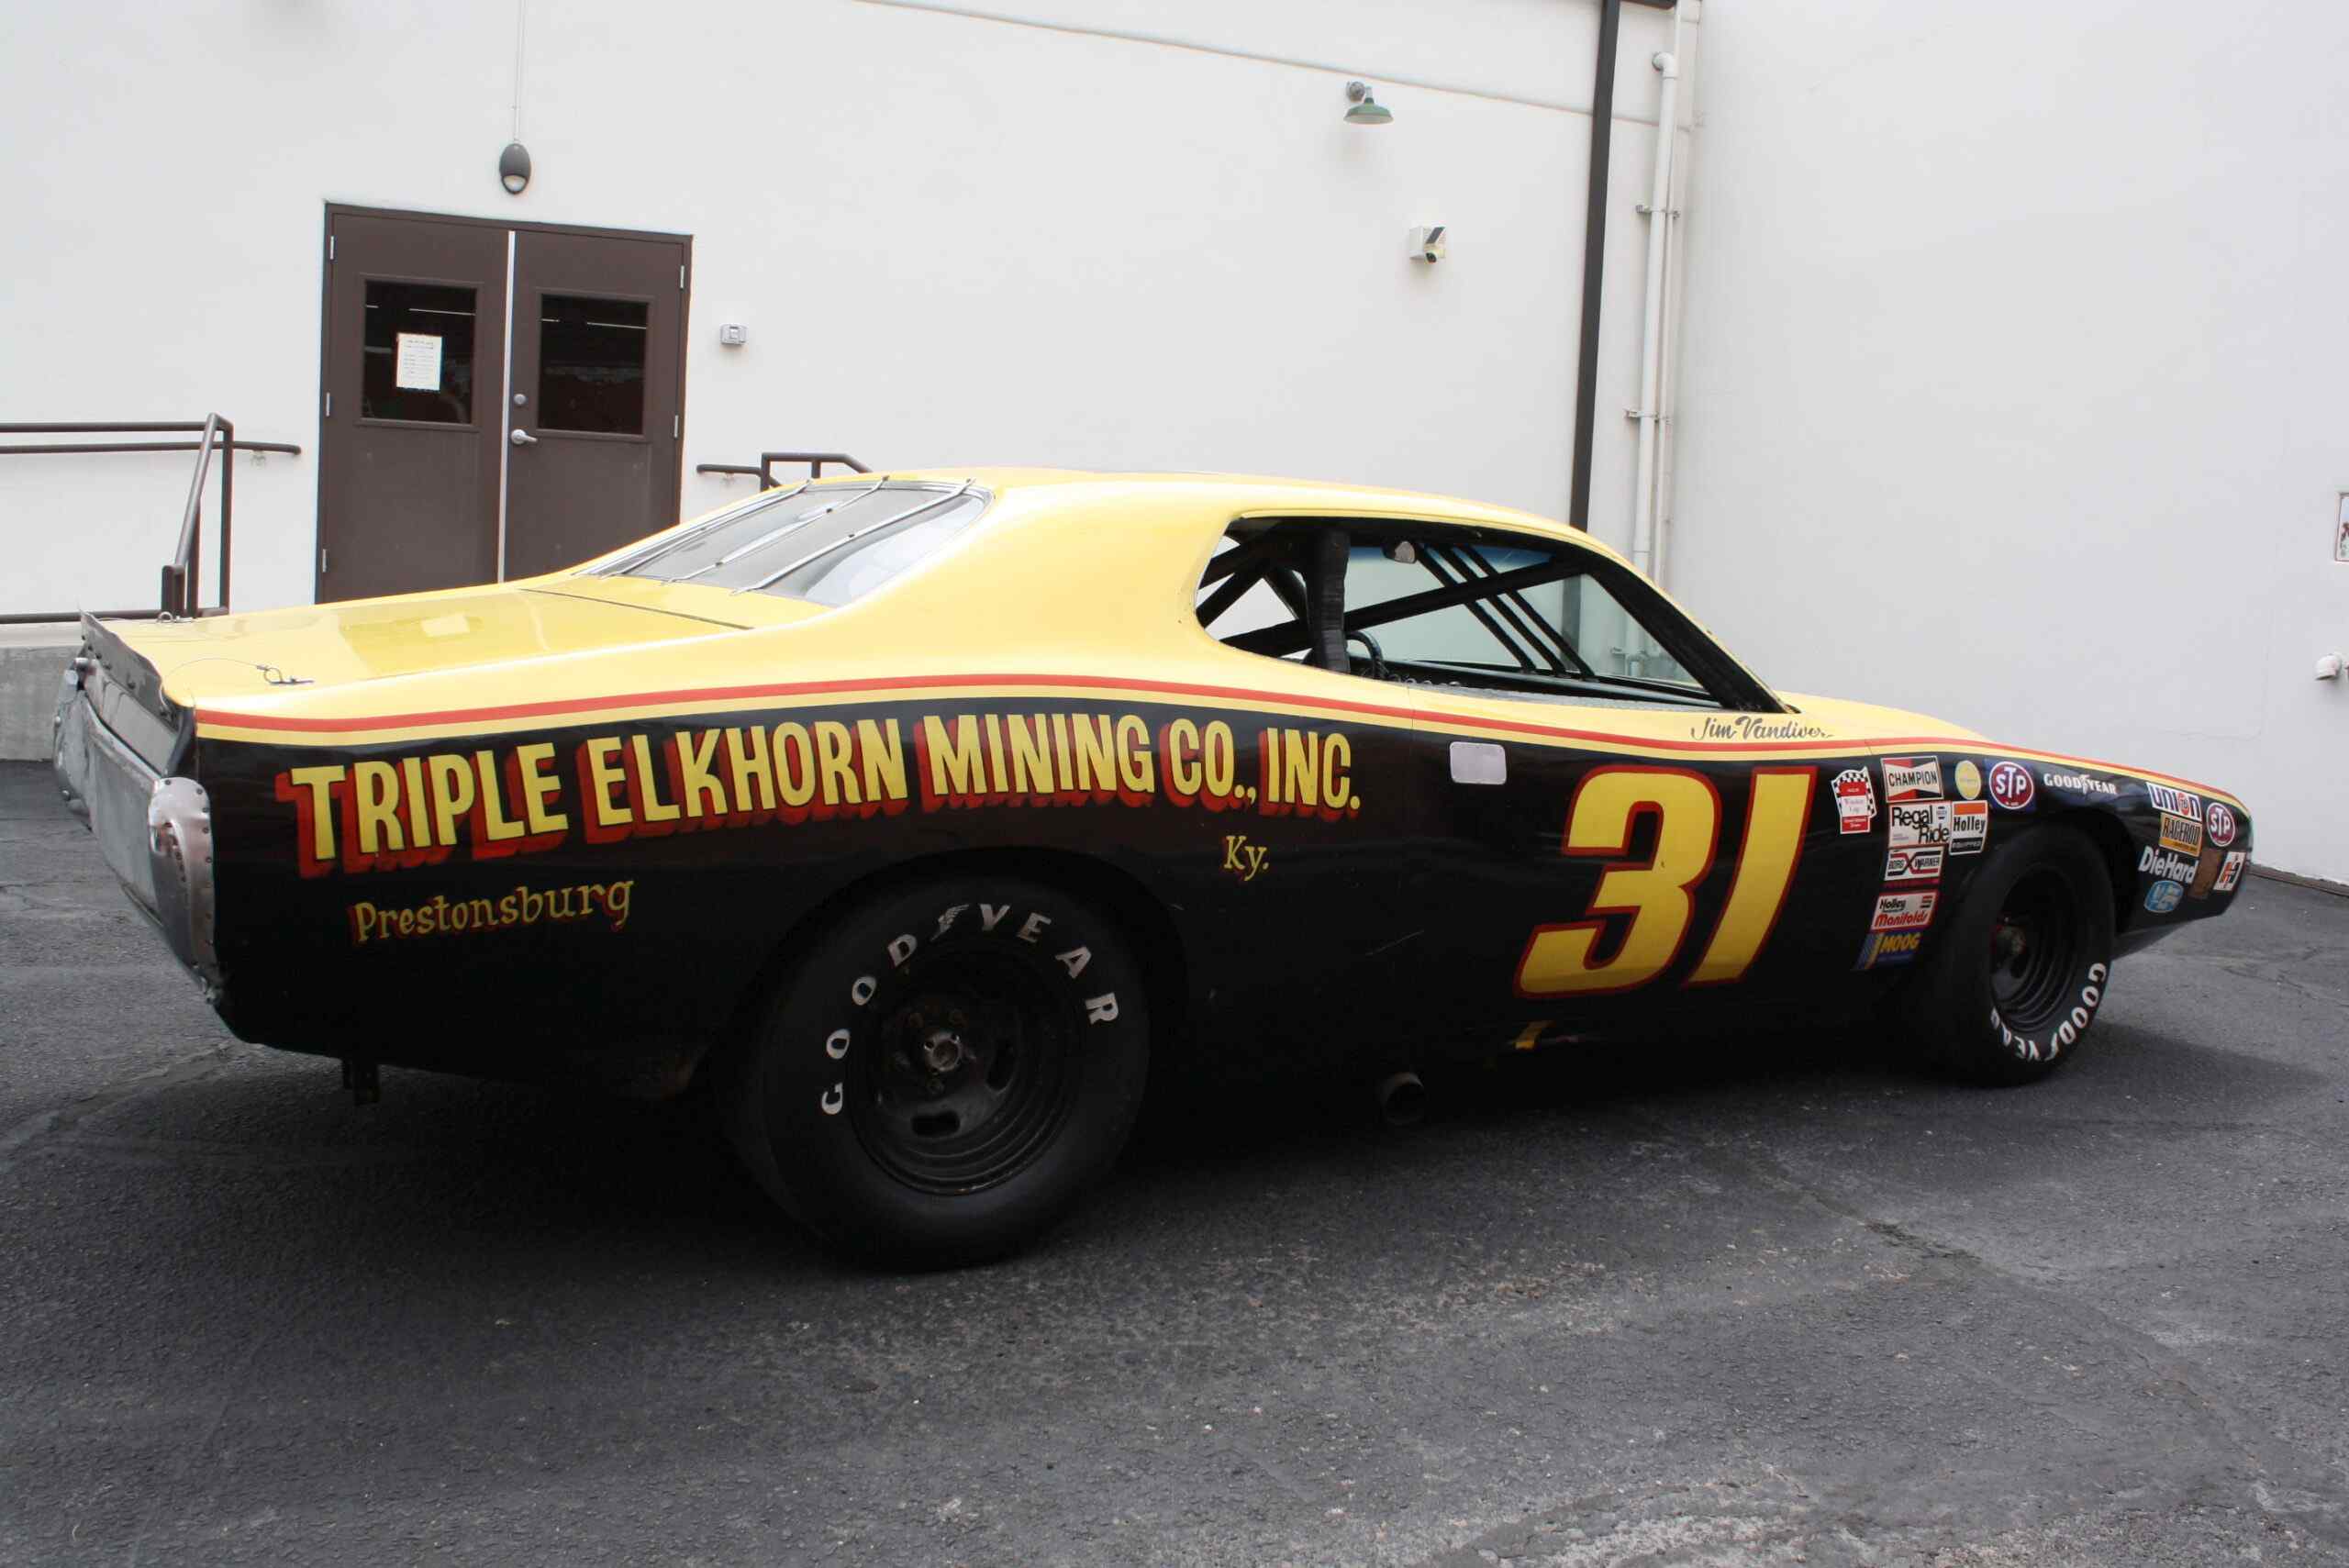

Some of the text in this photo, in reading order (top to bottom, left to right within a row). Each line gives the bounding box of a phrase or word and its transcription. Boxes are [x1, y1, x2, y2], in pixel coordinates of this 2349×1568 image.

[1690, 717, 1736, 740] Jim
[288, 740, 570, 862] TRIPLE
[584, 717, 910, 828] ELKHORN
[921, 713, 1156, 797] MINING
[1266, 727, 1362, 810] INC.
[1888, 770, 1938, 787] CHAMPION
[1995, 765, 2028, 799] STP
[2043, 773, 2118, 795] GOODYEAR
[1891, 805, 1933, 830] Regal
[1919, 823, 1950, 844] Ride
[1953, 815, 1987, 834] Holley
[2210, 806, 2231, 838] STP
[1222, 835, 1270, 881] Ky.
[2138, 845, 2199, 884] DieHard
[1514, 764, 1819, 998] 31
[353, 878, 635, 944] Prestonsburg
[1879, 897, 1907, 911] Holley
[820, 903, 1119, 1116] GOODYEAR
